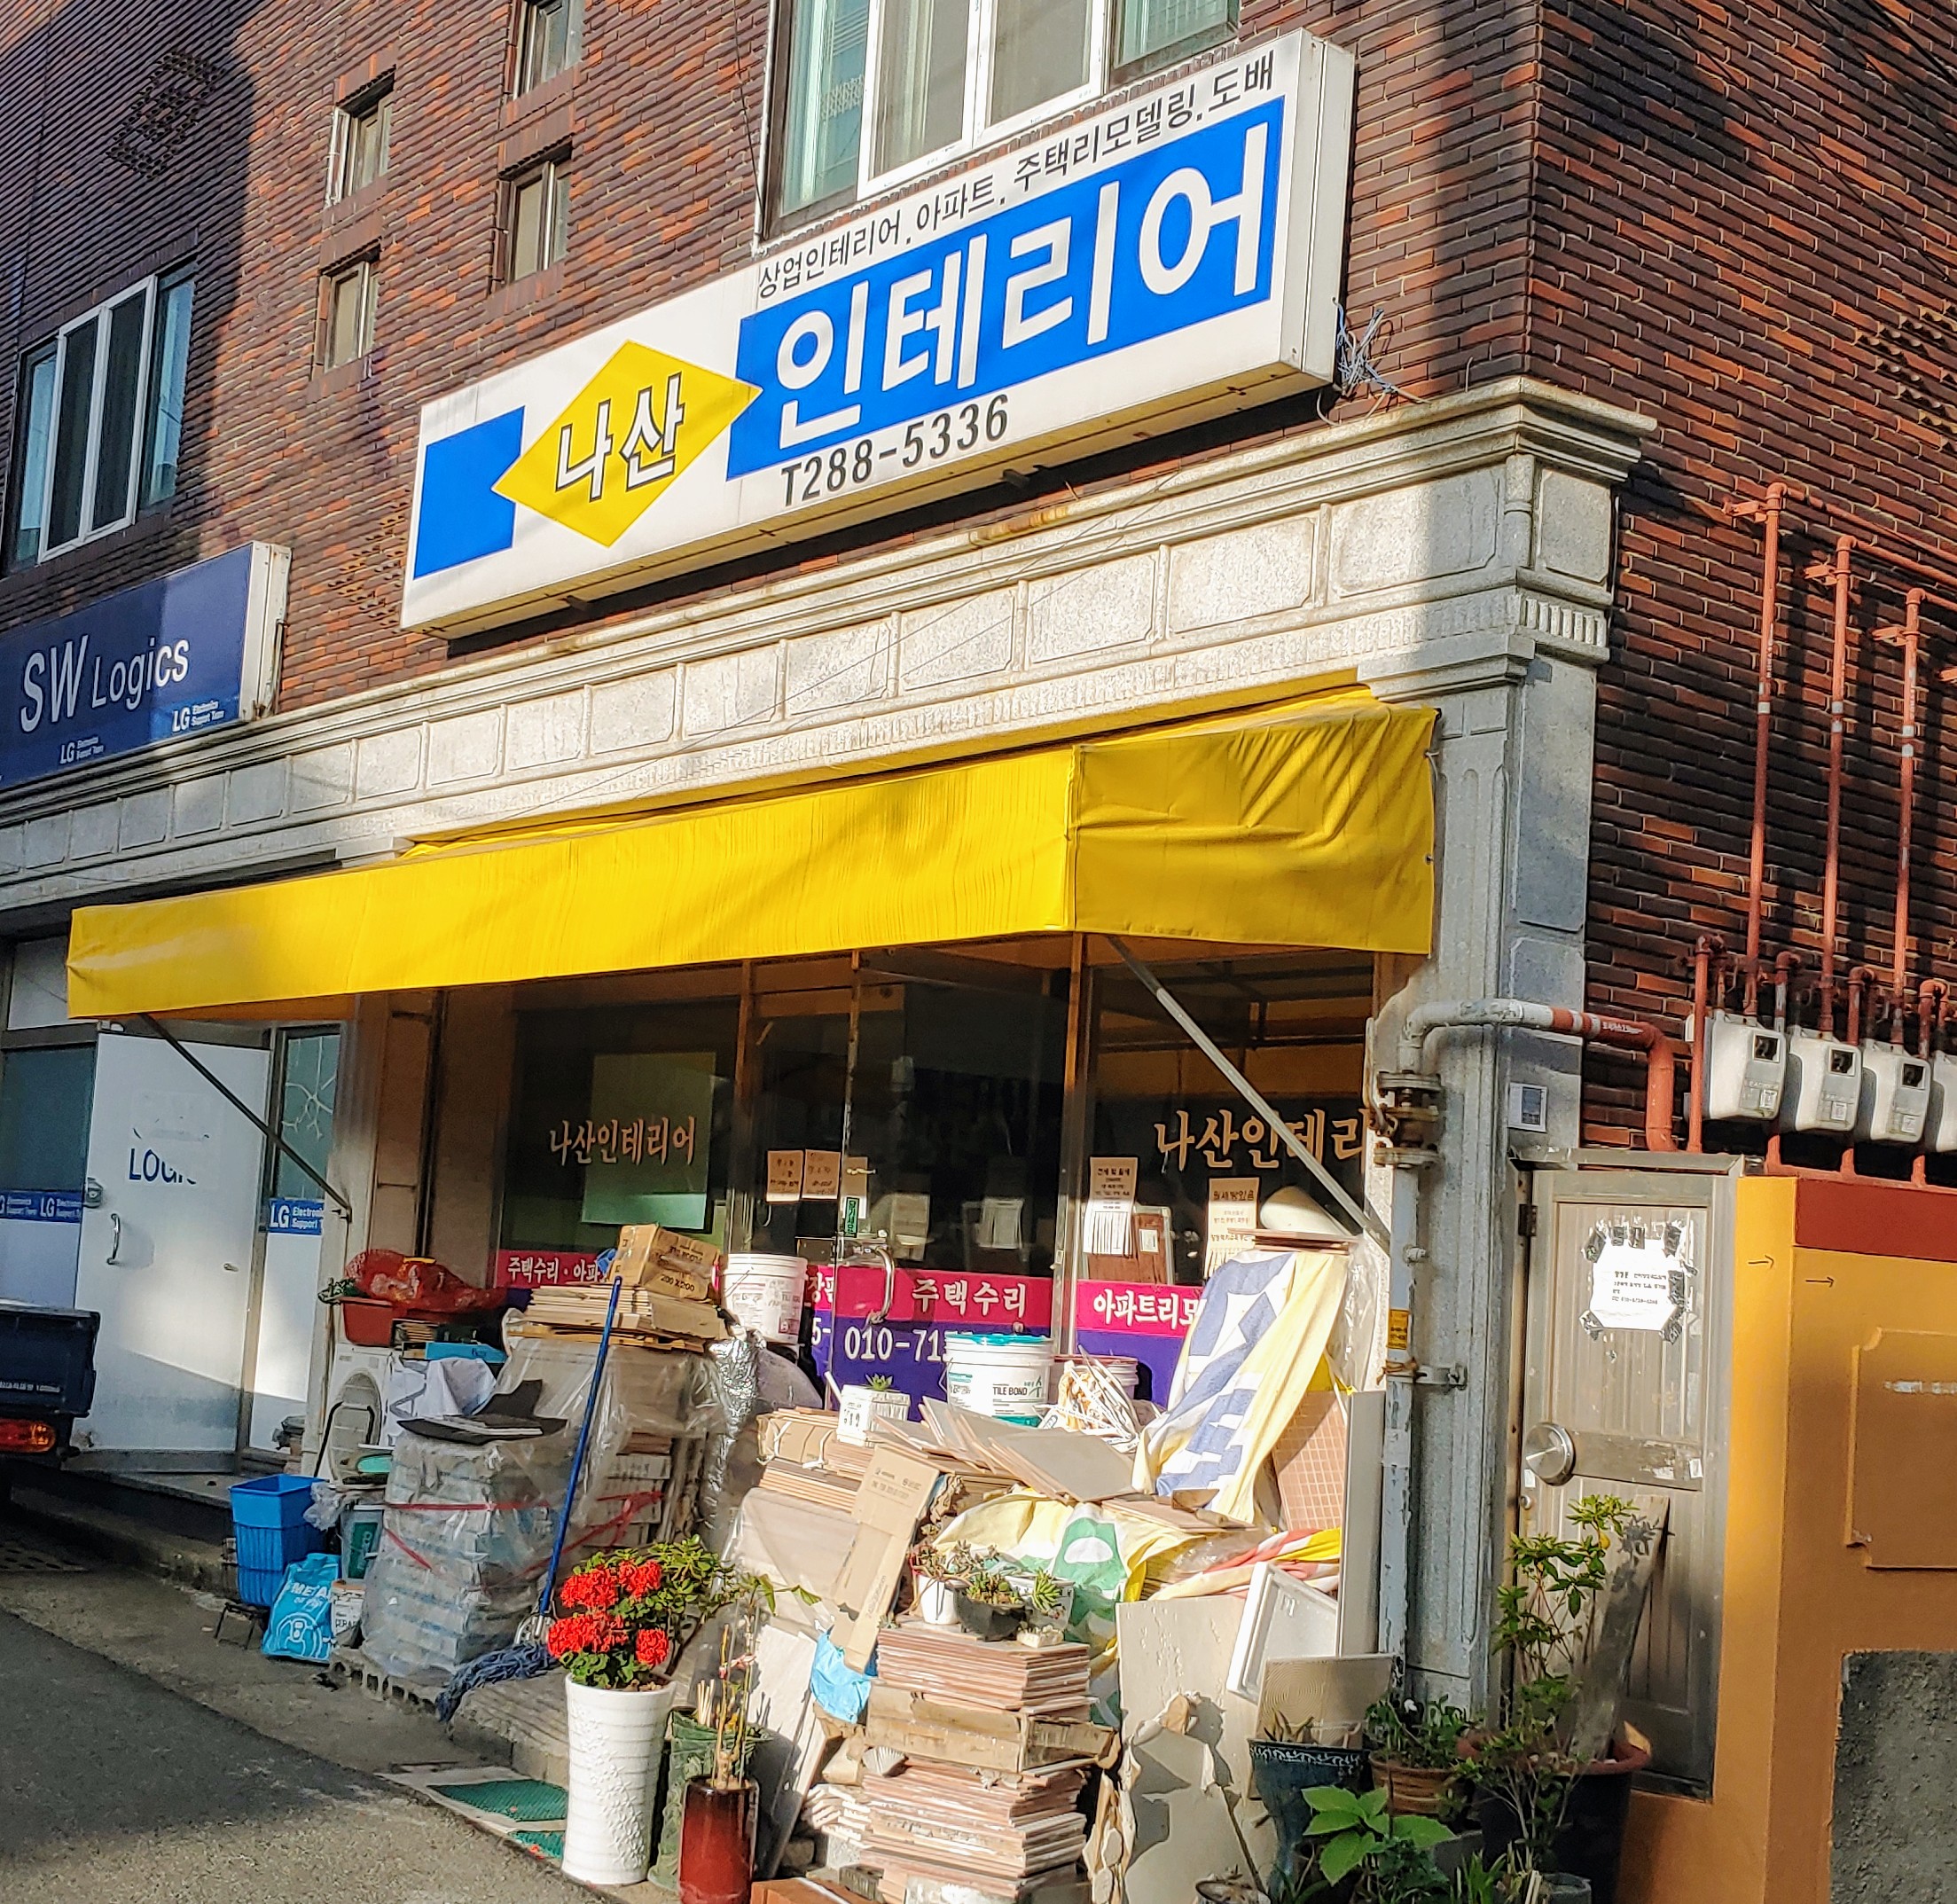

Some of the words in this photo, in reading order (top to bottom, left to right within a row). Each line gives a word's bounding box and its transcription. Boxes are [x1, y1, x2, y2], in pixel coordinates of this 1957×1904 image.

[1207, 49, 1275, 114] 도배
[776, 121, 1270, 451] 인테리어
[554, 371, 685, 503] 나산
[20, 634, 90, 733] SW
[90, 636, 191, 711] Logics
[171, 706, 192, 733] LG
[59, 741, 76, 764] LG
[549, 1115, 697, 1167] 나산인테리어
[40, 1196, 55, 1218] LG
[269, 1203, 290, 1228] LG
[507, 1256, 560, 1285] 주택수리
[573, 1258, 607, 1283] 아파
[911, 1278, 1027, 1320] 주택수리
[844, 1325, 973, 1362] 010-71
[992, 1386, 1007, 1396] TILE
[1008, 1386, 1029, 1396] BOND
